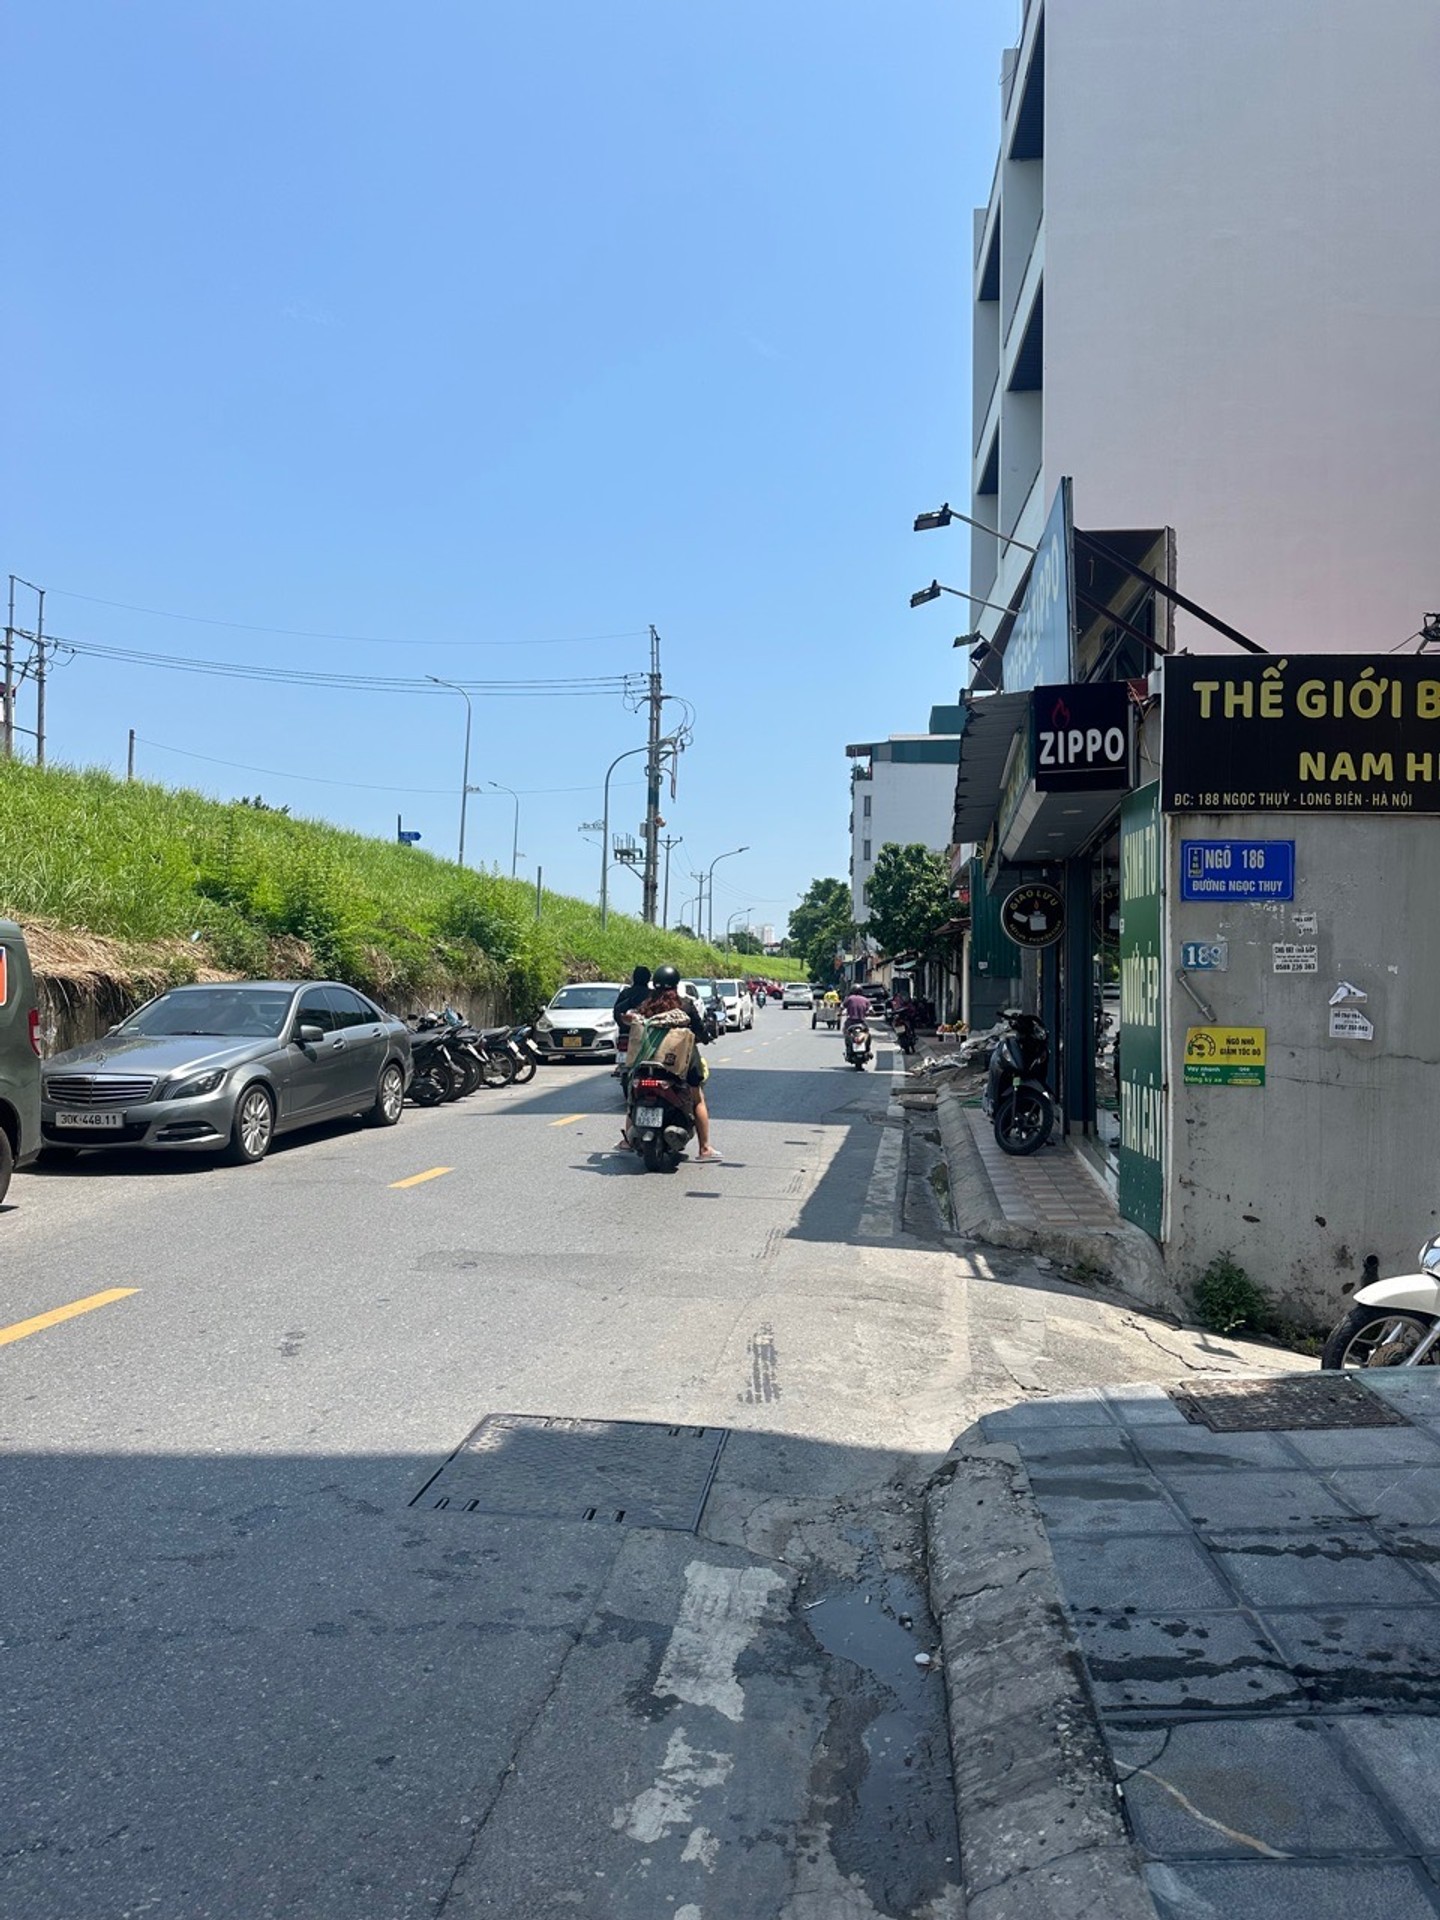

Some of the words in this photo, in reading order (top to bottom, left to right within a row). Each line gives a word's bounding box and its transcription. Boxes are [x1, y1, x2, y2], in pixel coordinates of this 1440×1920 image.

[1192, 658, 1288, 719] THẾ
[1296, 666, 1402, 719] GIỚI
[1039, 727, 1125, 765] ZIPPO
[1299, 751, 1394, 782] NAM
[1407, 752, 1440, 782] H
[1174, 793, 1194, 806] ĐC:
[1198, 793, 1219, 806] 188
[1223, 793, 1256, 808] NGỌC
[1300, 793, 1332, 806] LONG
[1335, 791, 1362, 806] BIÊN
[1372, 791, 1389, 806] HÀ
[1392, 790, 1413, 808] NỘI
[1123, 828, 1144, 901] SINH
[1145, 796, 1157, 895] TỐ
[1205, 844, 1231, 869] NGÕ
[1242, 849, 1265, 869] 186
[1009, 890, 1034, 910] GIAO
[1192, 877, 1227, 892] ĐƯỜNG
[1228, 880, 1256, 896] NGỌC
[1258, 880, 1283, 896] THỤY
[1187, 945, 1222, 966] 188
[1122, 941, 1146, 1026] NƯỚC
[1147, 940, 1159, 1027] ÉP
[1219, 1045, 1237, 1056] GIẢM
[1238, 1046, 1250, 1056] TỐC
[1121, 1068, 1140, 1153] TRÁI
[1141, 1072, 1161, 1162] CÂY
